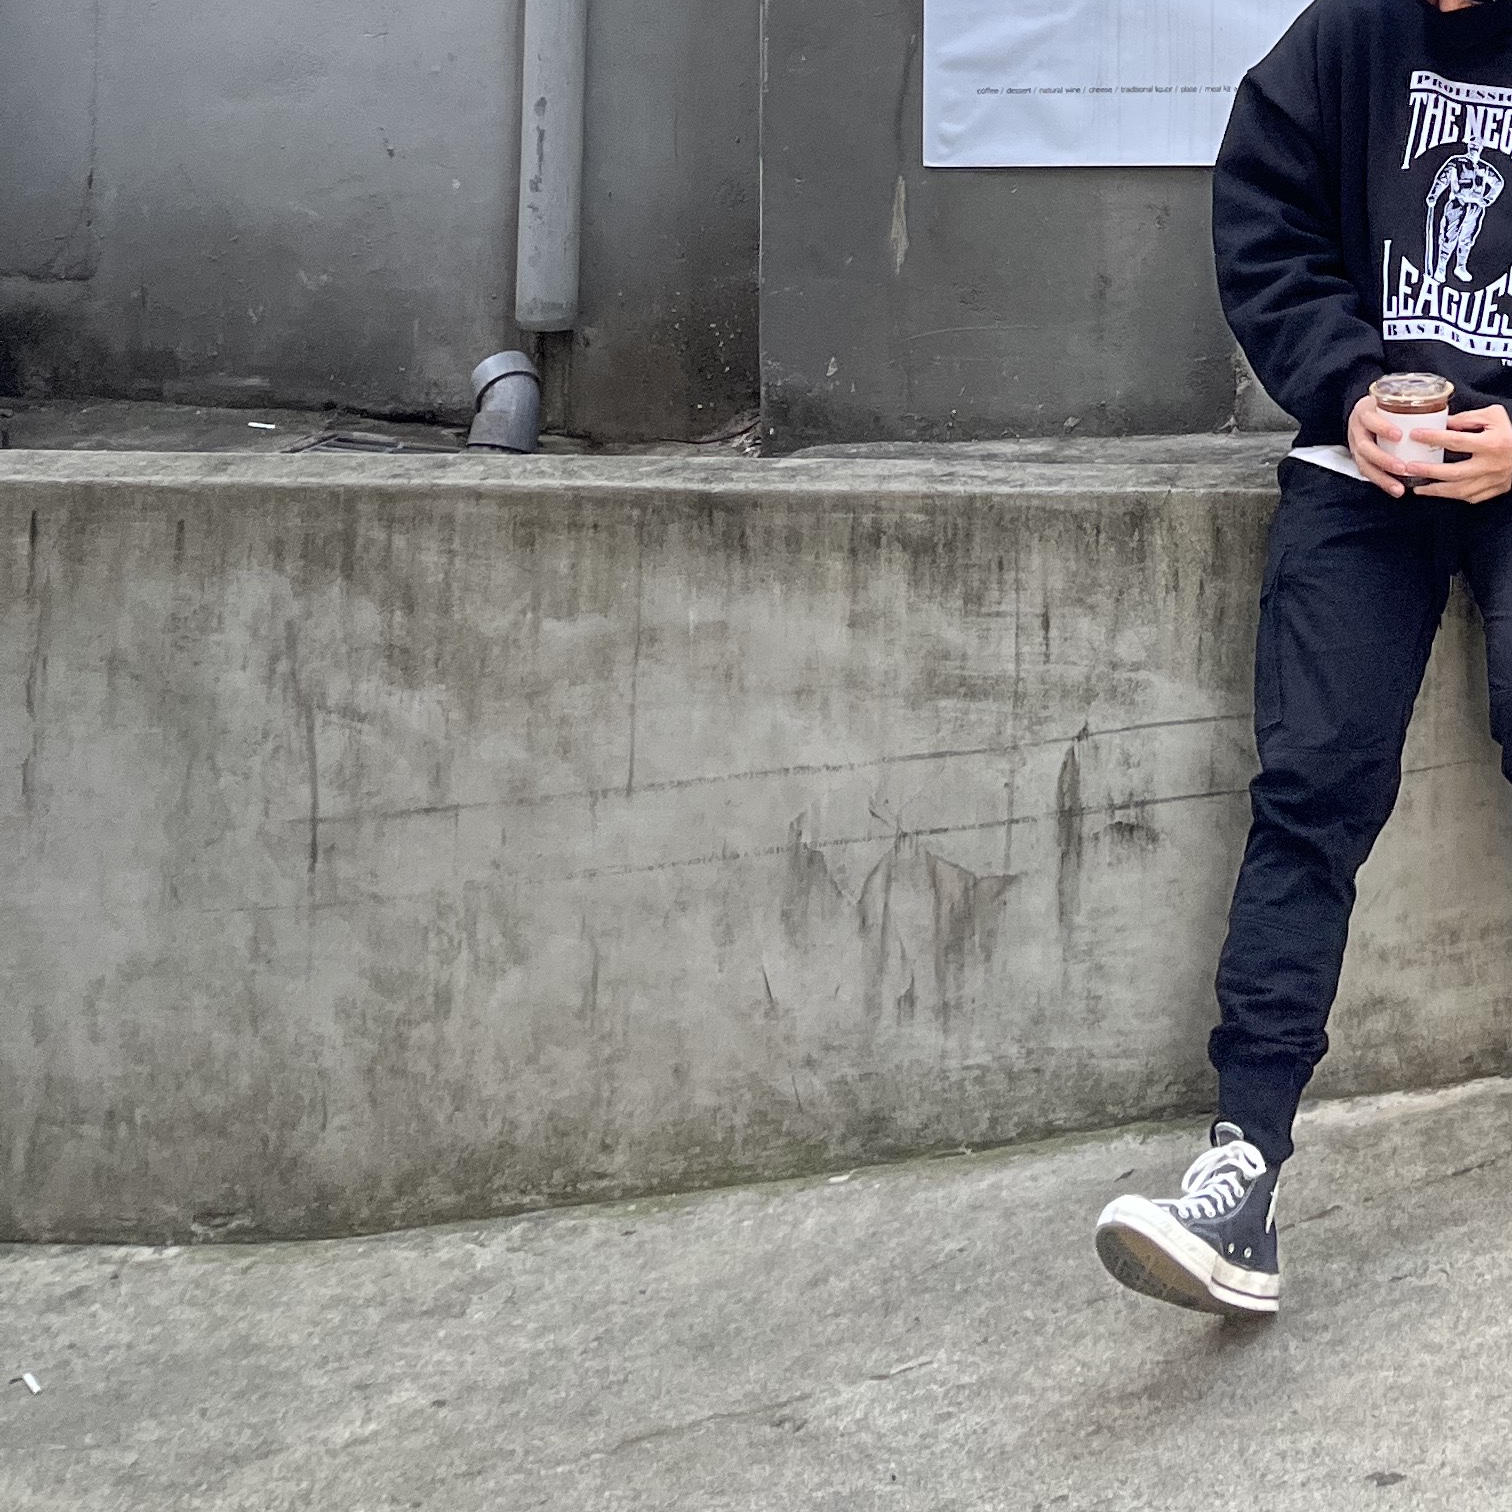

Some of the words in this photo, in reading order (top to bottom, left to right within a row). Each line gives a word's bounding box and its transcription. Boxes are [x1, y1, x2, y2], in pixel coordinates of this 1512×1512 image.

[976, 86, 999, 94] coffee
[1006, 86, 1032, 94] dessert
[1039, 86, 1063, 94] natural
[1401, 92, 1463, 170] THE
[1387, 324, 1512, 353] BASEBALL
